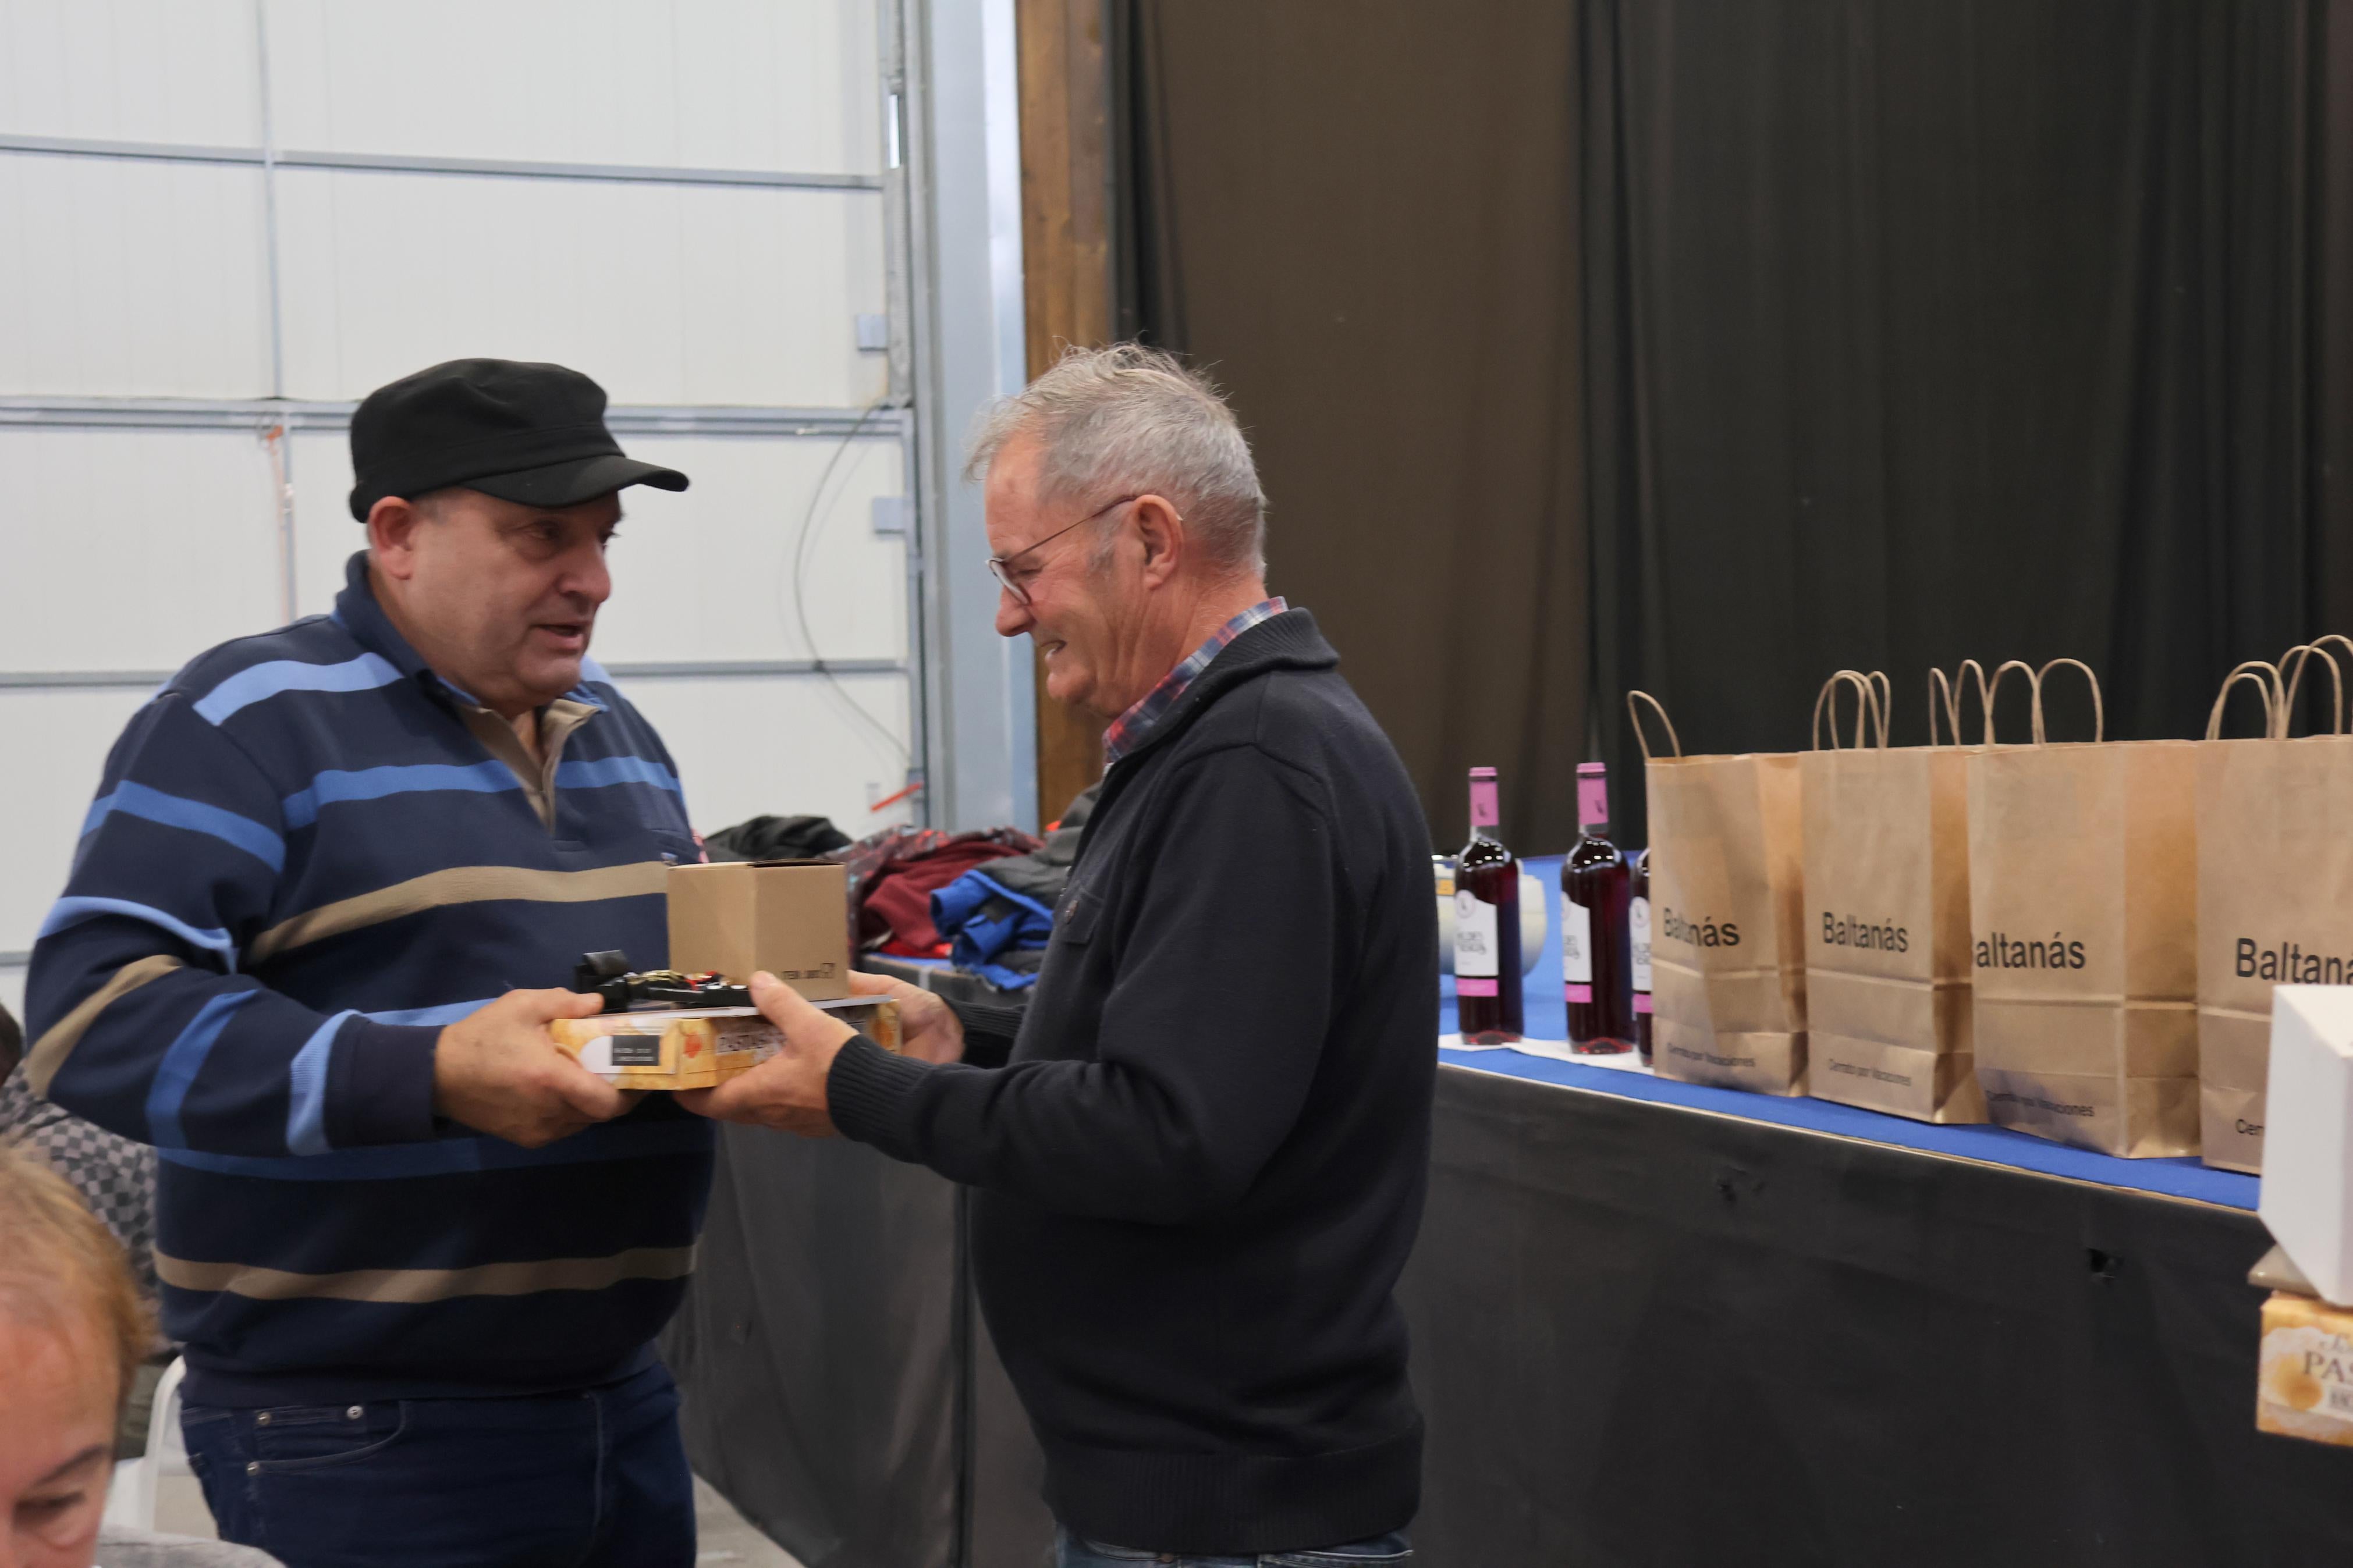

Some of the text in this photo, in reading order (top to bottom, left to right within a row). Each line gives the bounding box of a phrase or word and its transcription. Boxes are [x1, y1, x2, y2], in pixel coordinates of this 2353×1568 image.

[1822, 911, 1909, 953] Baltanás
[1974, 931, 2086, 969] altanás
[2304, 1349, 2353, 1384] PA
